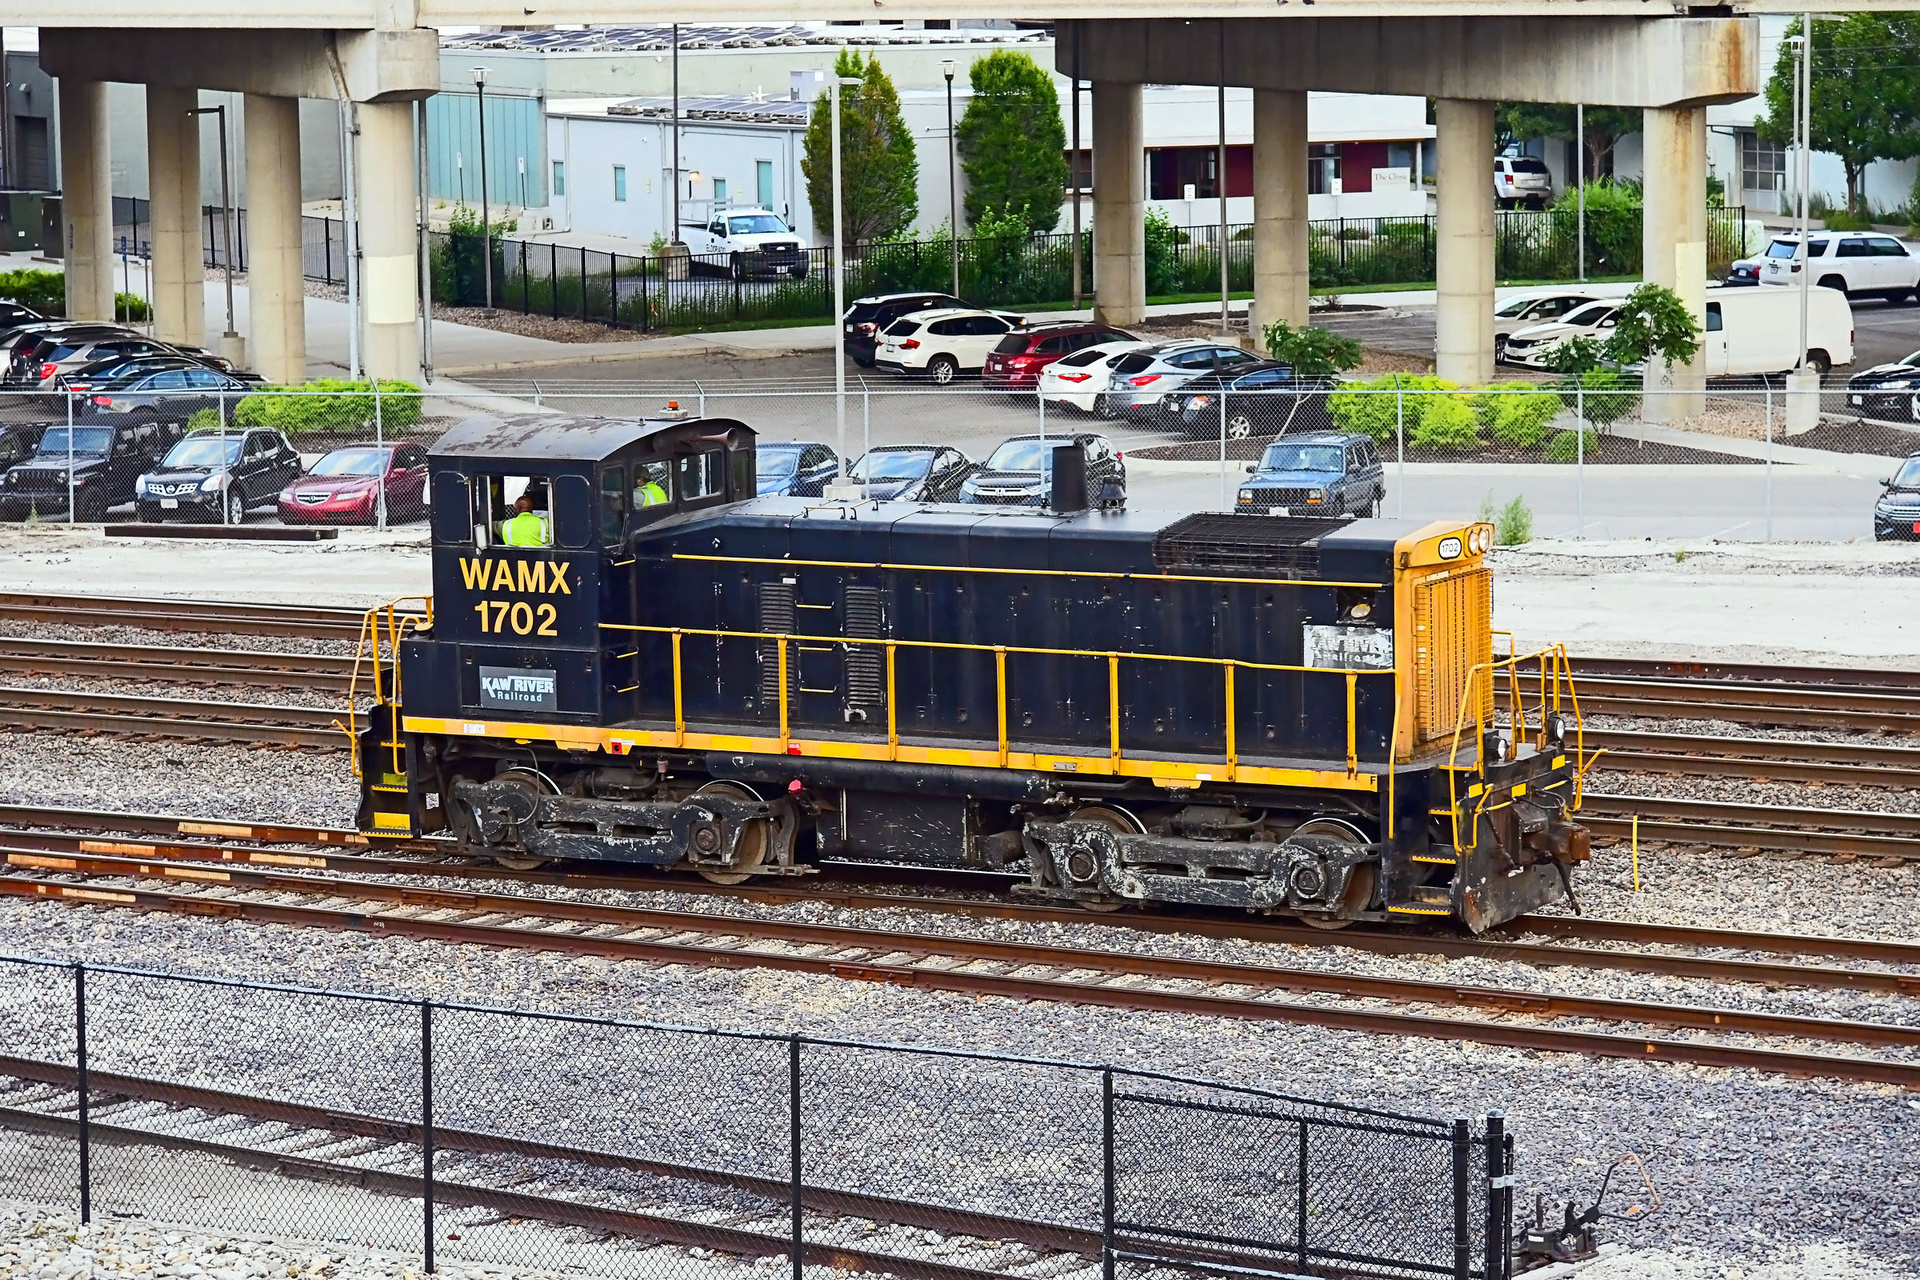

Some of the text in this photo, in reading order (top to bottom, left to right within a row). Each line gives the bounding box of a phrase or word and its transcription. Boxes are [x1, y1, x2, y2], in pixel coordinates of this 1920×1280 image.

[1442, 542, 1458, 553] 1702
[459, 557, 571, 594] WAMX
[474, 600, 557, 636] 1702
[482, 676, 553, 697] KAW RIVER
[497, 691, 542, 702] Railroad
[1370, 776, 1376, 785] F
